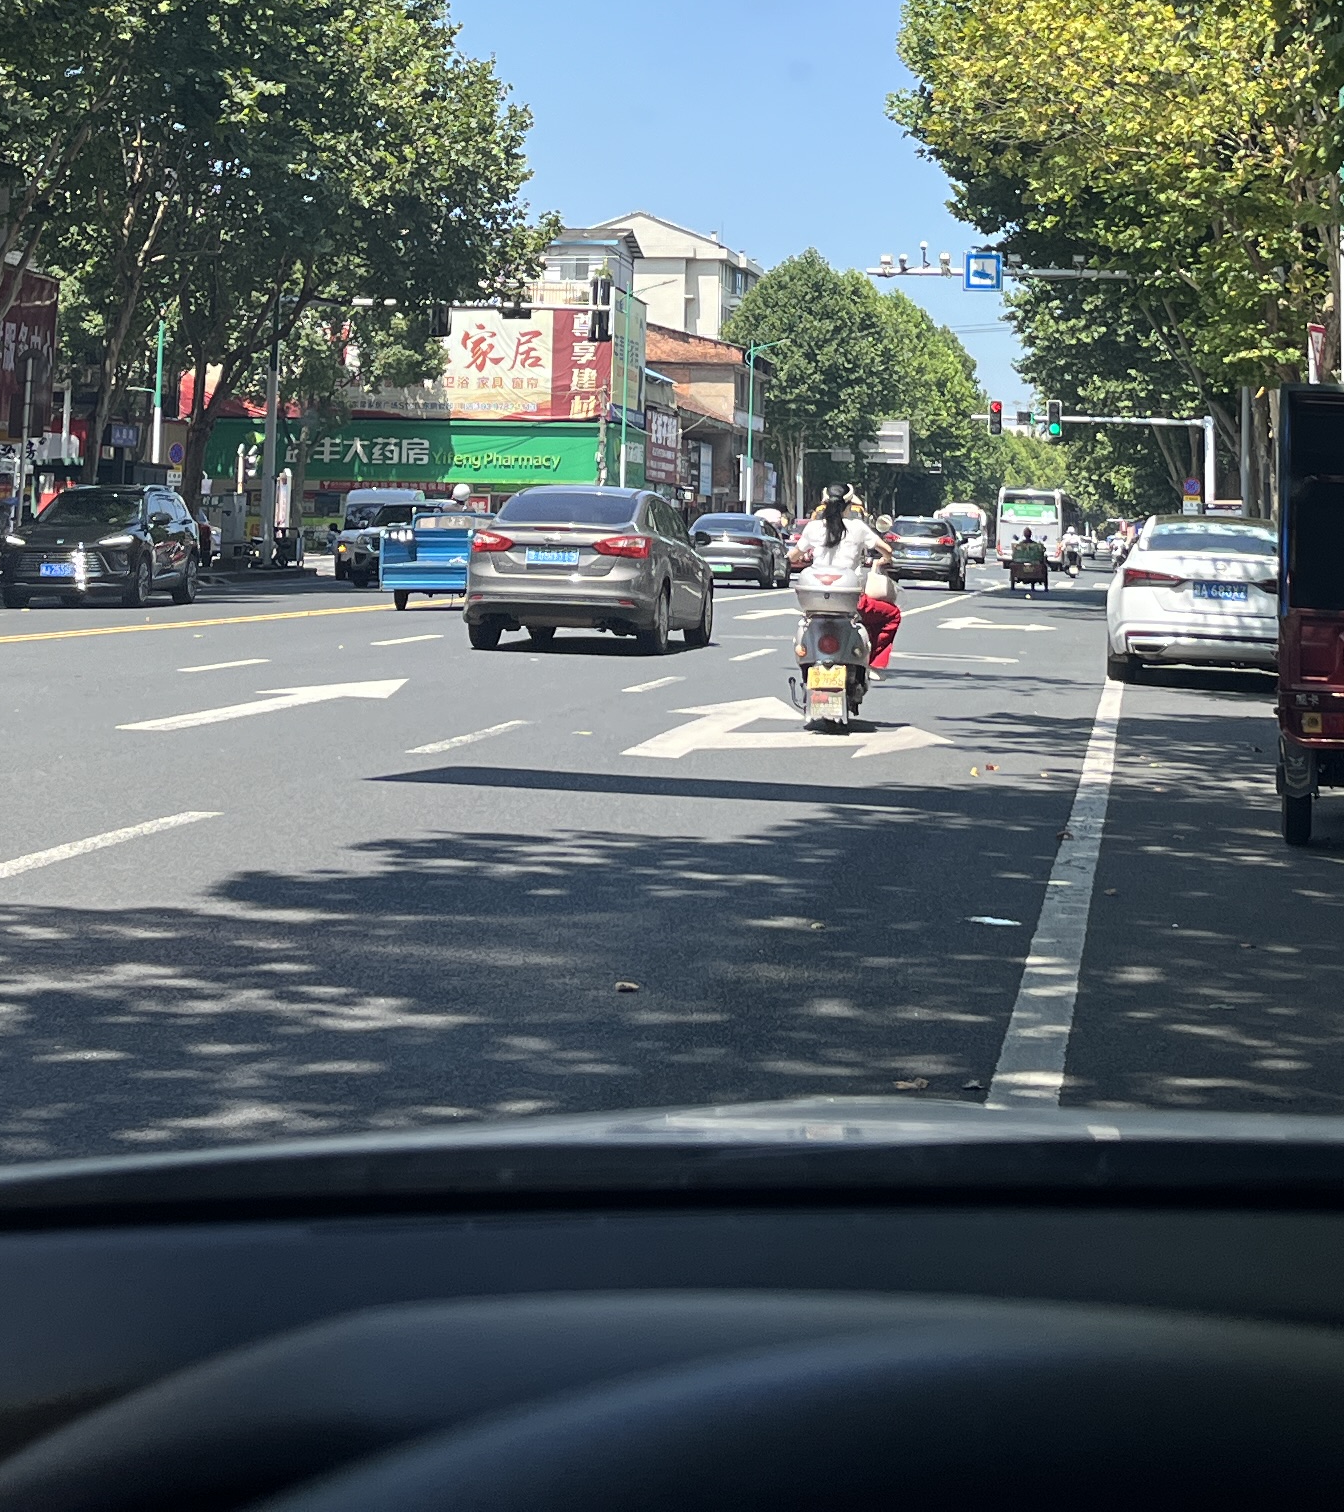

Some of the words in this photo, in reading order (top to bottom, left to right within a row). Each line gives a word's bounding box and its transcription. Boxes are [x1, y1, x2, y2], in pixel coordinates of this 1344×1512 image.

[460, 322, 546, 374] 家居
[444, 376, 470, 389] 卫浴
[476, 376, 504, 389] 家具
[433, 449, 480, 469] Yifeng
[482, 451, 562, 473] Pharmacy
